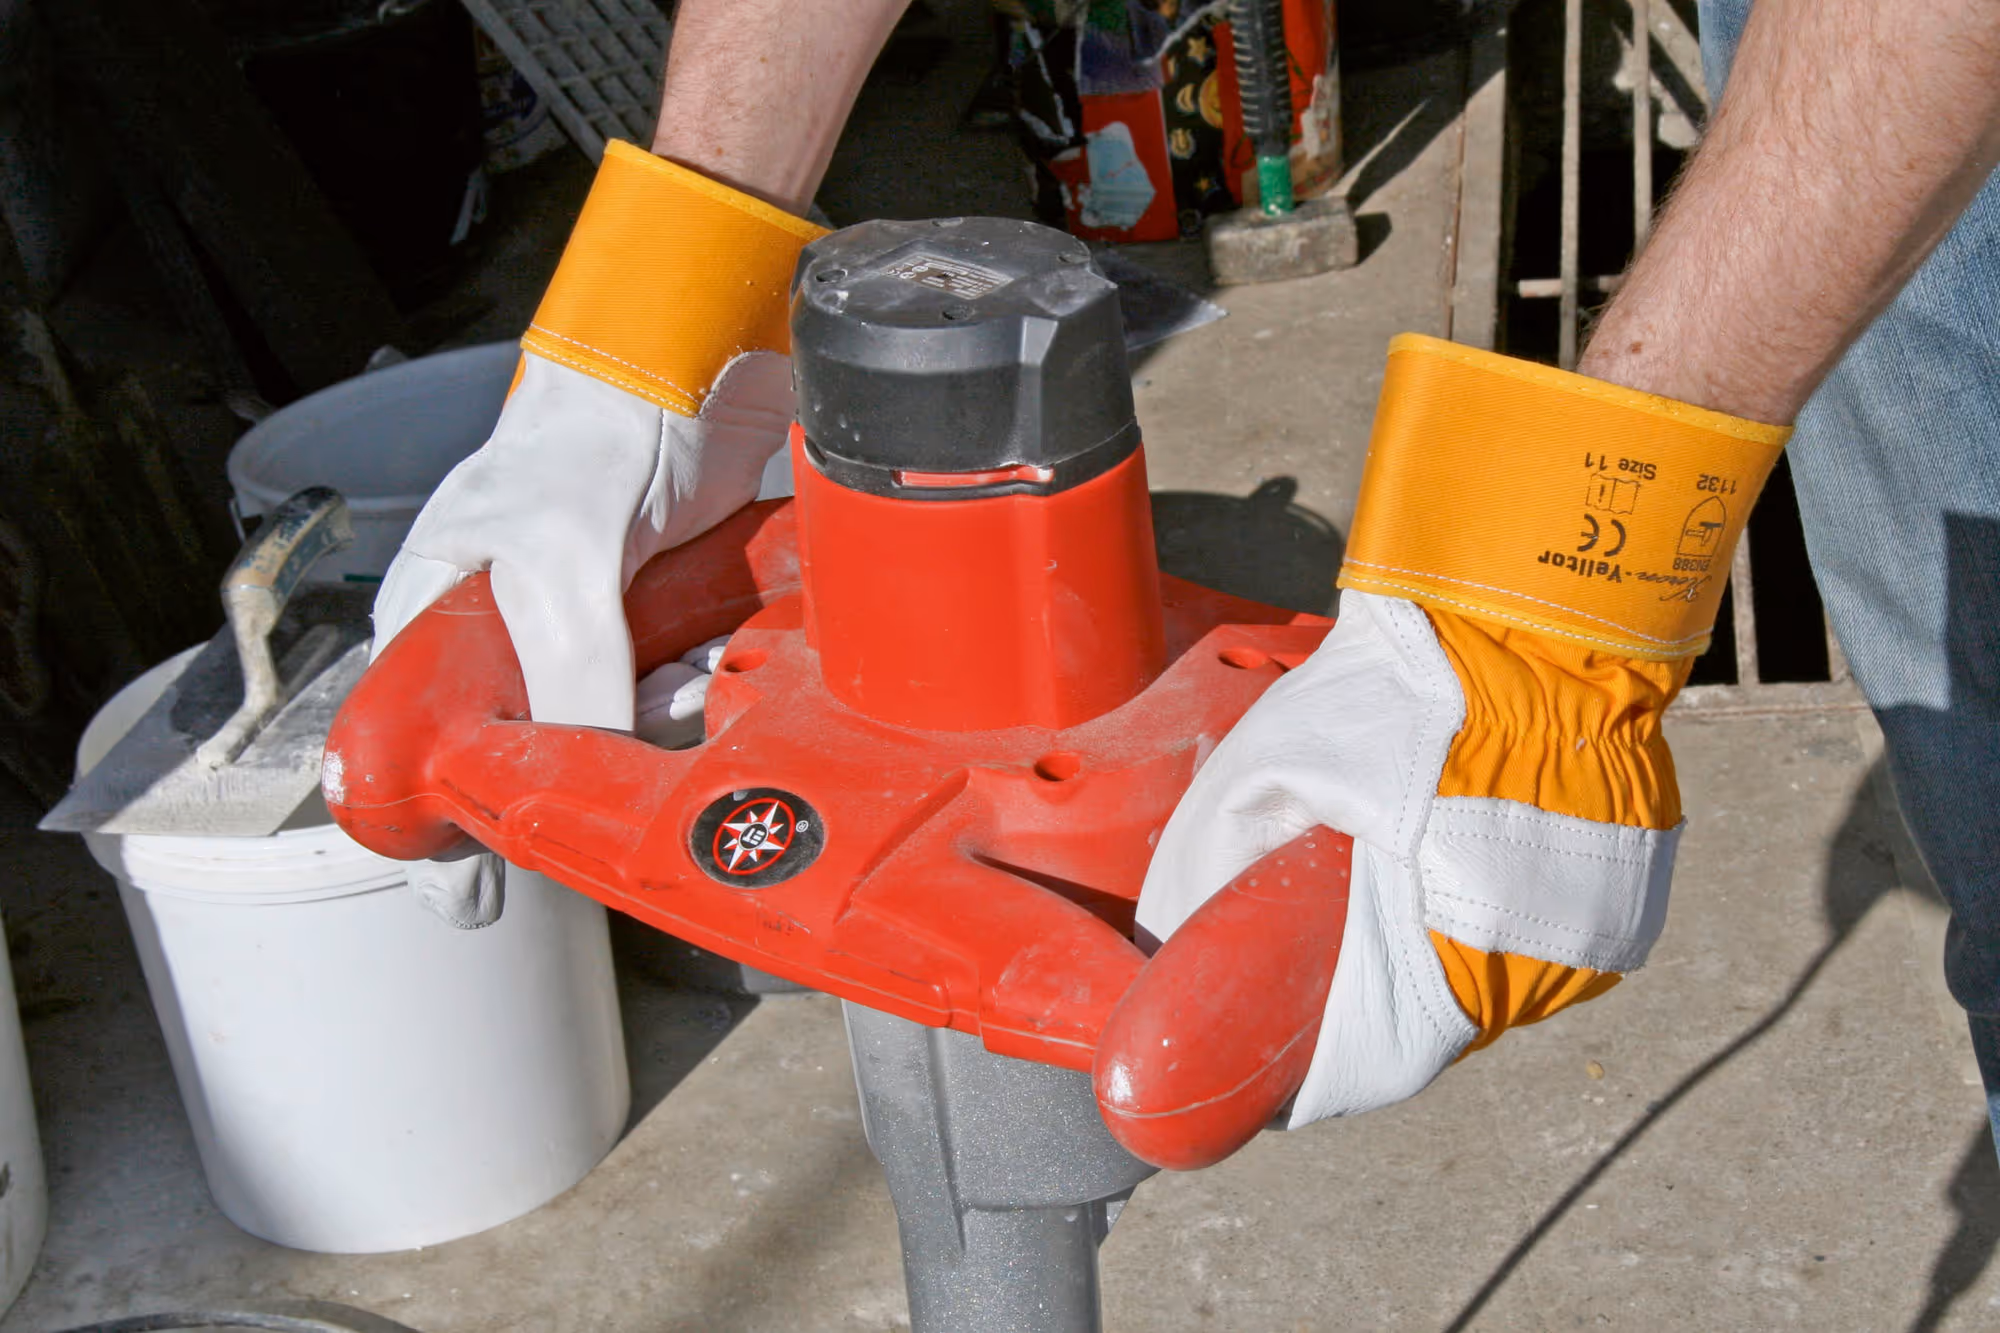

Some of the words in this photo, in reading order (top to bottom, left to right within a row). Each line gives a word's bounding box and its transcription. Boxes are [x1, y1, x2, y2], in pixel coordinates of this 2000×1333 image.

[1585, 452, 1608, 471] 11
[1618, 458, 1657, 480] Size
[1696, 474, 1737, 495] 1132
[1576, 513, 1627, 557] CE
[1672, 557, 1712, 572] EN388
